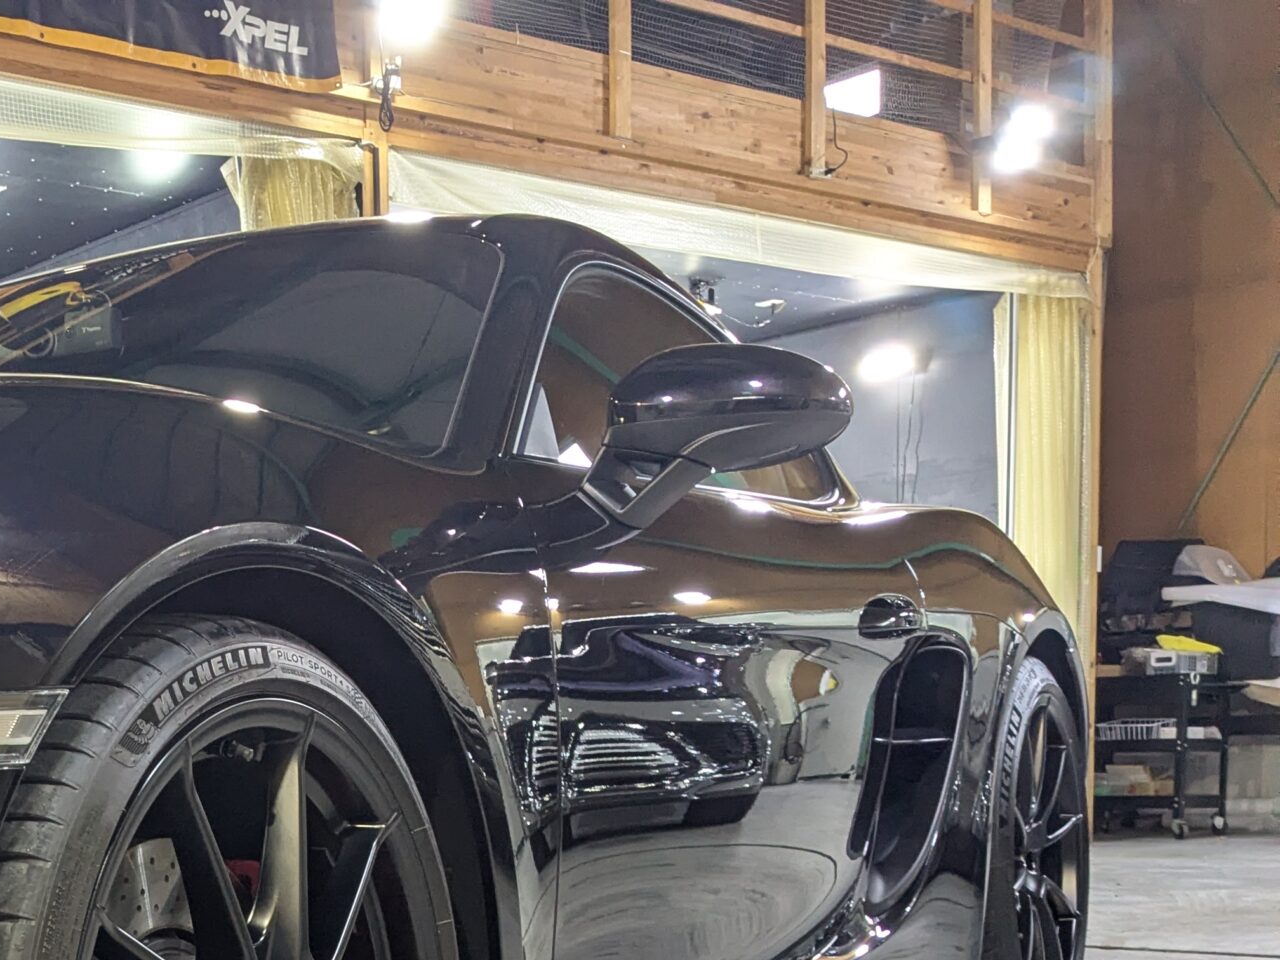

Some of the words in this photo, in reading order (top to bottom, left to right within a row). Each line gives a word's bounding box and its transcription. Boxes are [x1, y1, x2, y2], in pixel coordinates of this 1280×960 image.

[219, 0, 308, 56] XPEL
[153, 647, 264, 720] MICHELIN
[277, 650, 304, 665] PILOT
[308, 659, 338, 684] SPORT
[1000, 709, 1021, 815] MICHELIN
